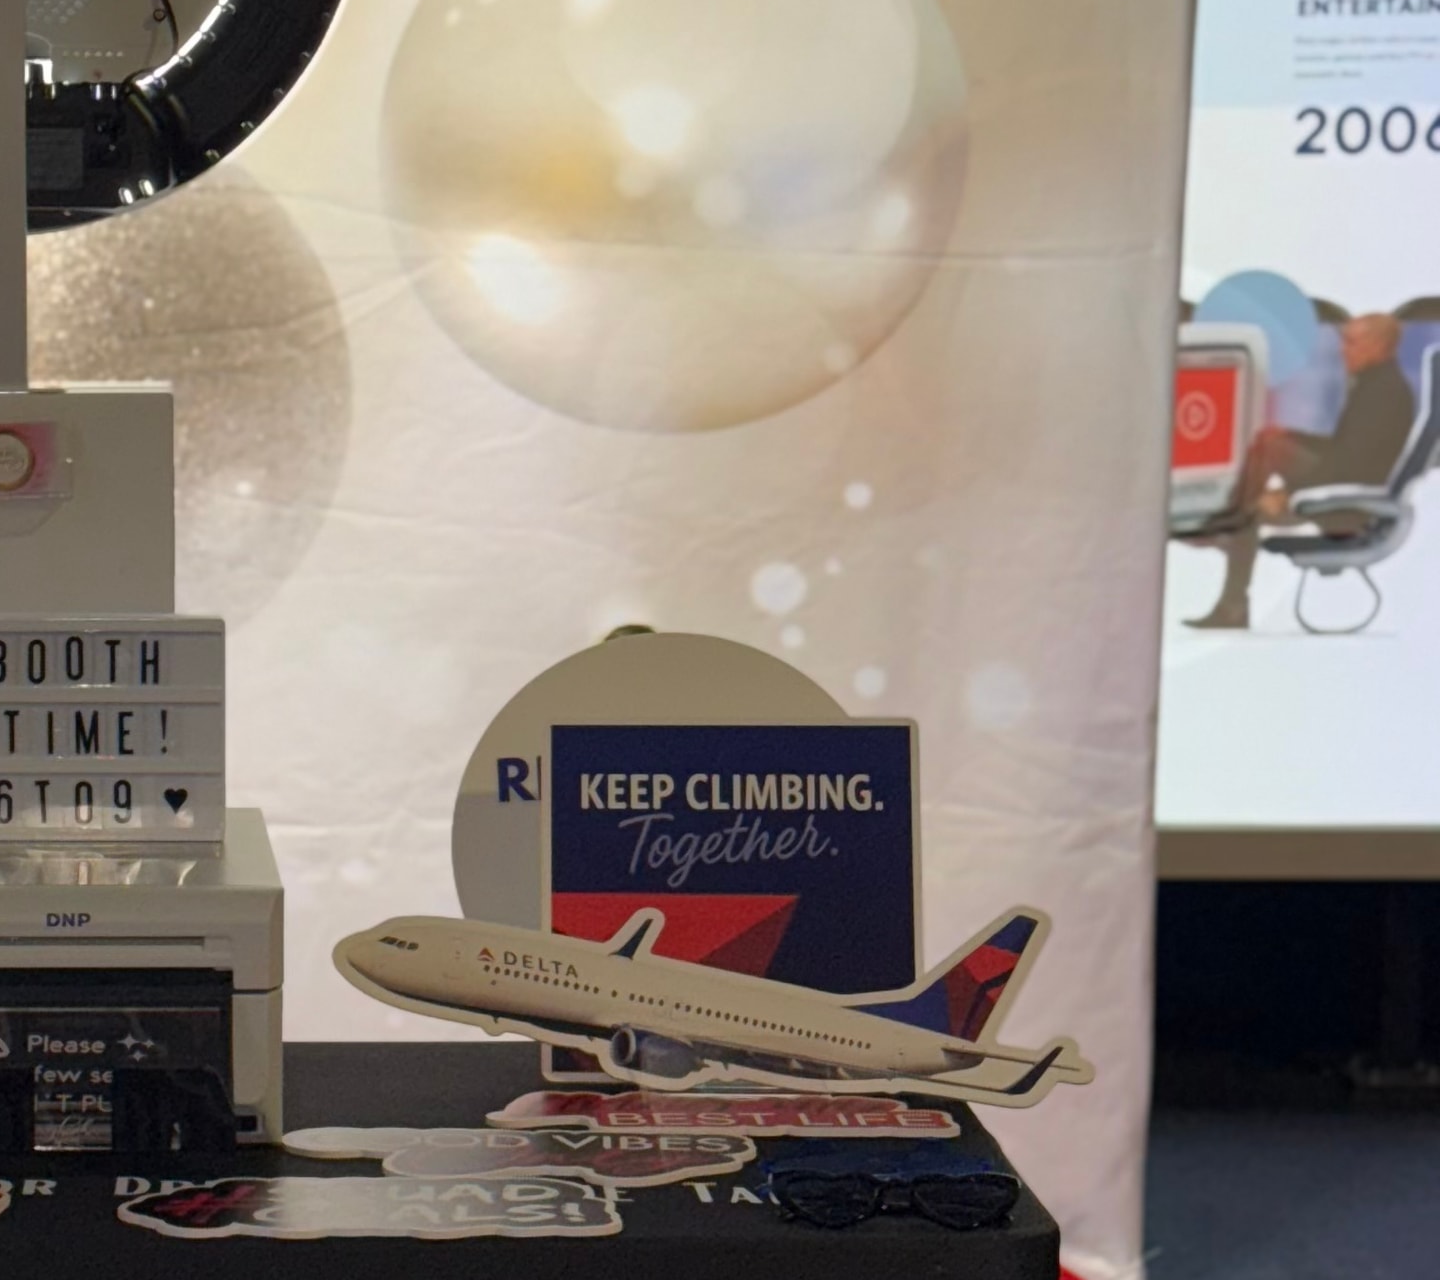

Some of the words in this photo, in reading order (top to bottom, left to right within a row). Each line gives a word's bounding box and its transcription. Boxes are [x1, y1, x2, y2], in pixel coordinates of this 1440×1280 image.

[3, 709, 169, 755] TIME!
[580, 772, 675, 810] KEEP
[685, 772, 885, 811] CLIMBING.
[618, 812, 840, 889] Together.
[46, 912, 91, 927] DNP
[503, 950, 579, 979] DELTA
[26, 1034, 107, 1054] Please
[34, 1065, 82, 1083] few
[607, 1111, 774, 1127] BEST
[552, 1134, 732, 1152] VIBES
